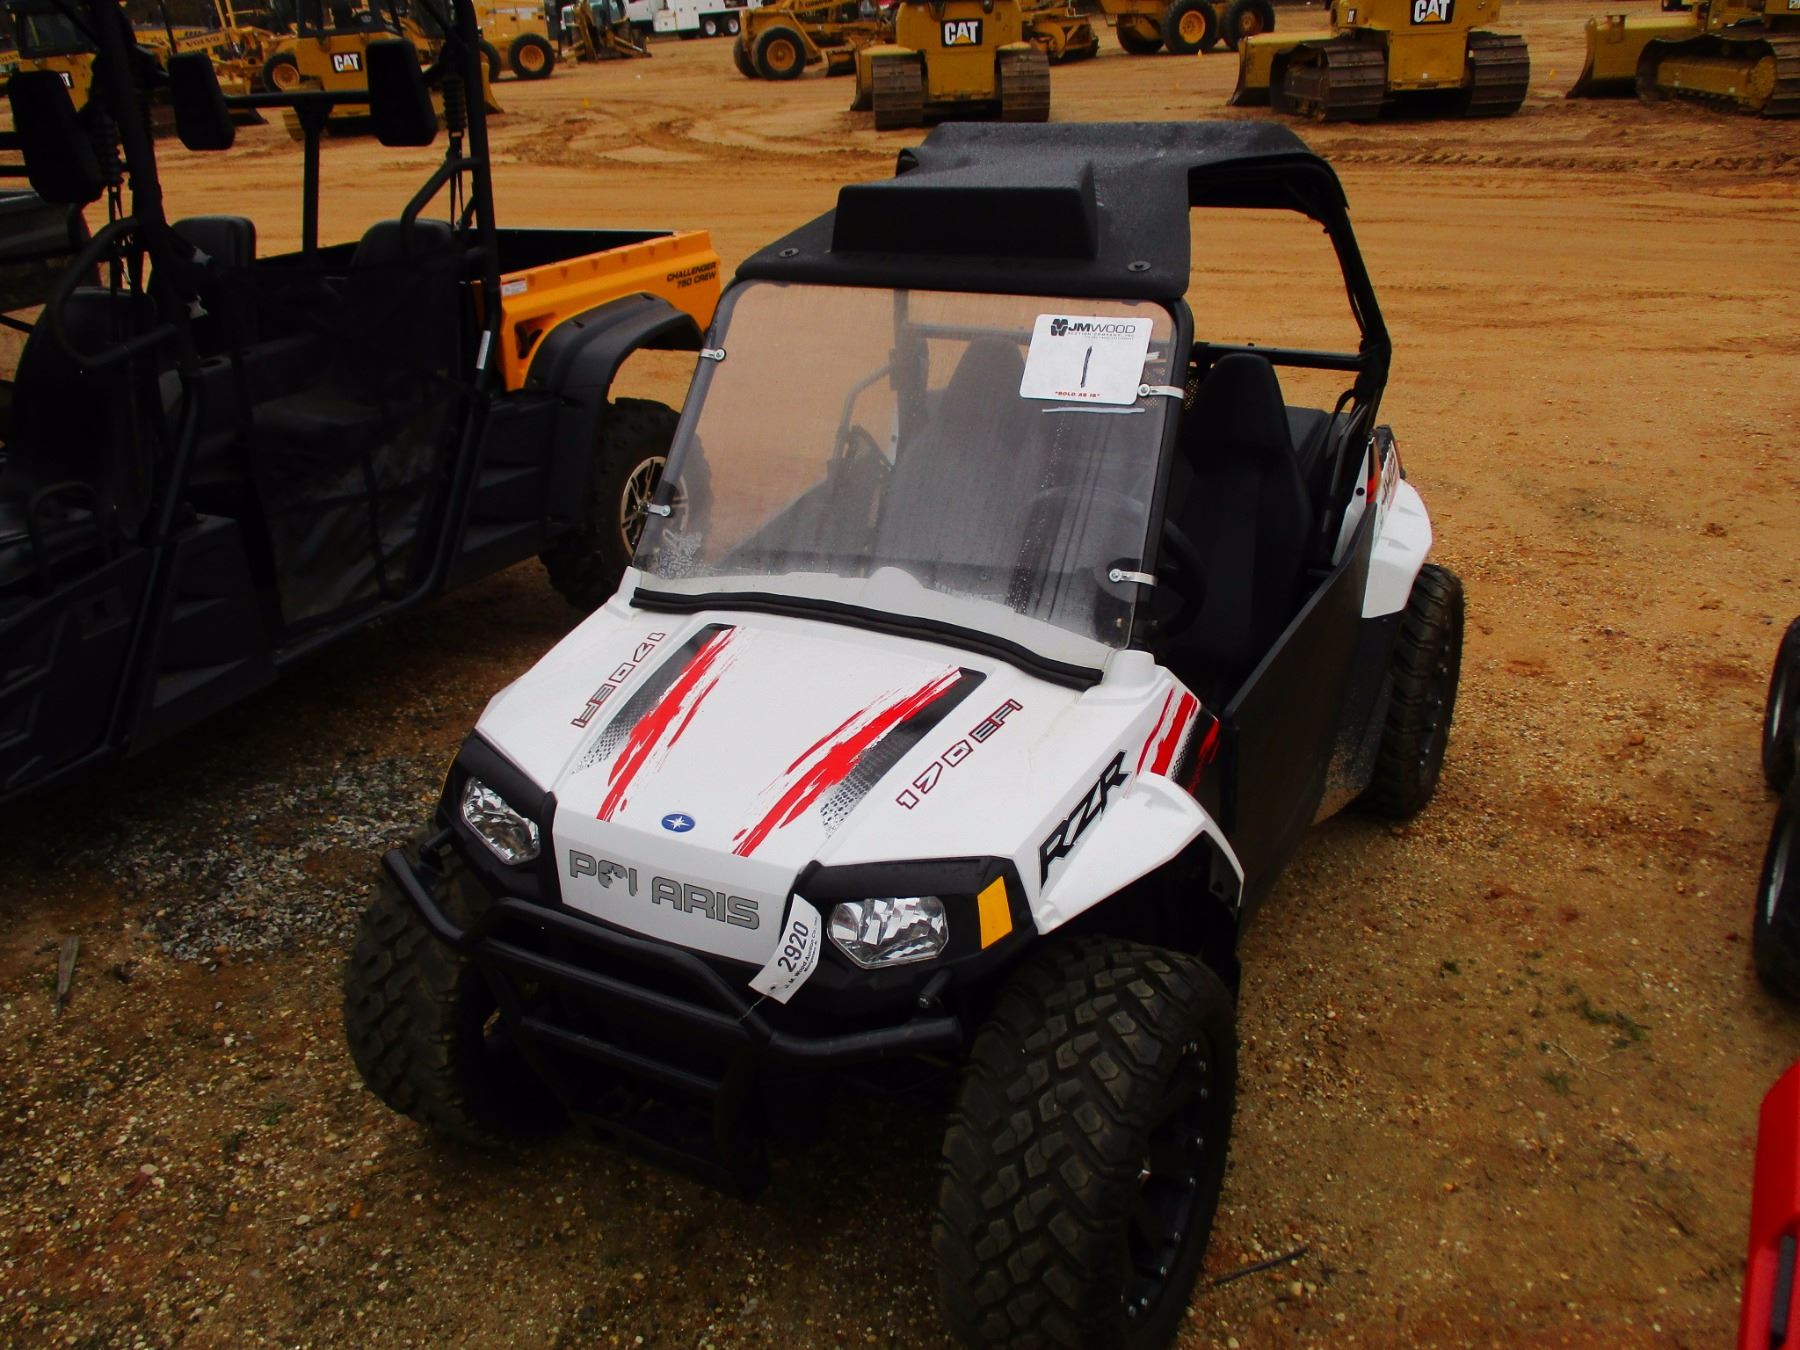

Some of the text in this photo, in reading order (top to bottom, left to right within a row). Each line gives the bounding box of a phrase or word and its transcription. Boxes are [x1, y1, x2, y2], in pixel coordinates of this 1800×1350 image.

[1413, 0, 1451, 23] CAT
[944, 21, 979, 46] CAT
[333, 53, 360, 72] CAT
[666, 261, 717, 283] CHALLENGER
[693, 272, 717, 284] CREW
[1038, 750, 1130, 891] RZR
[777, 920, 809, 973] 2920
